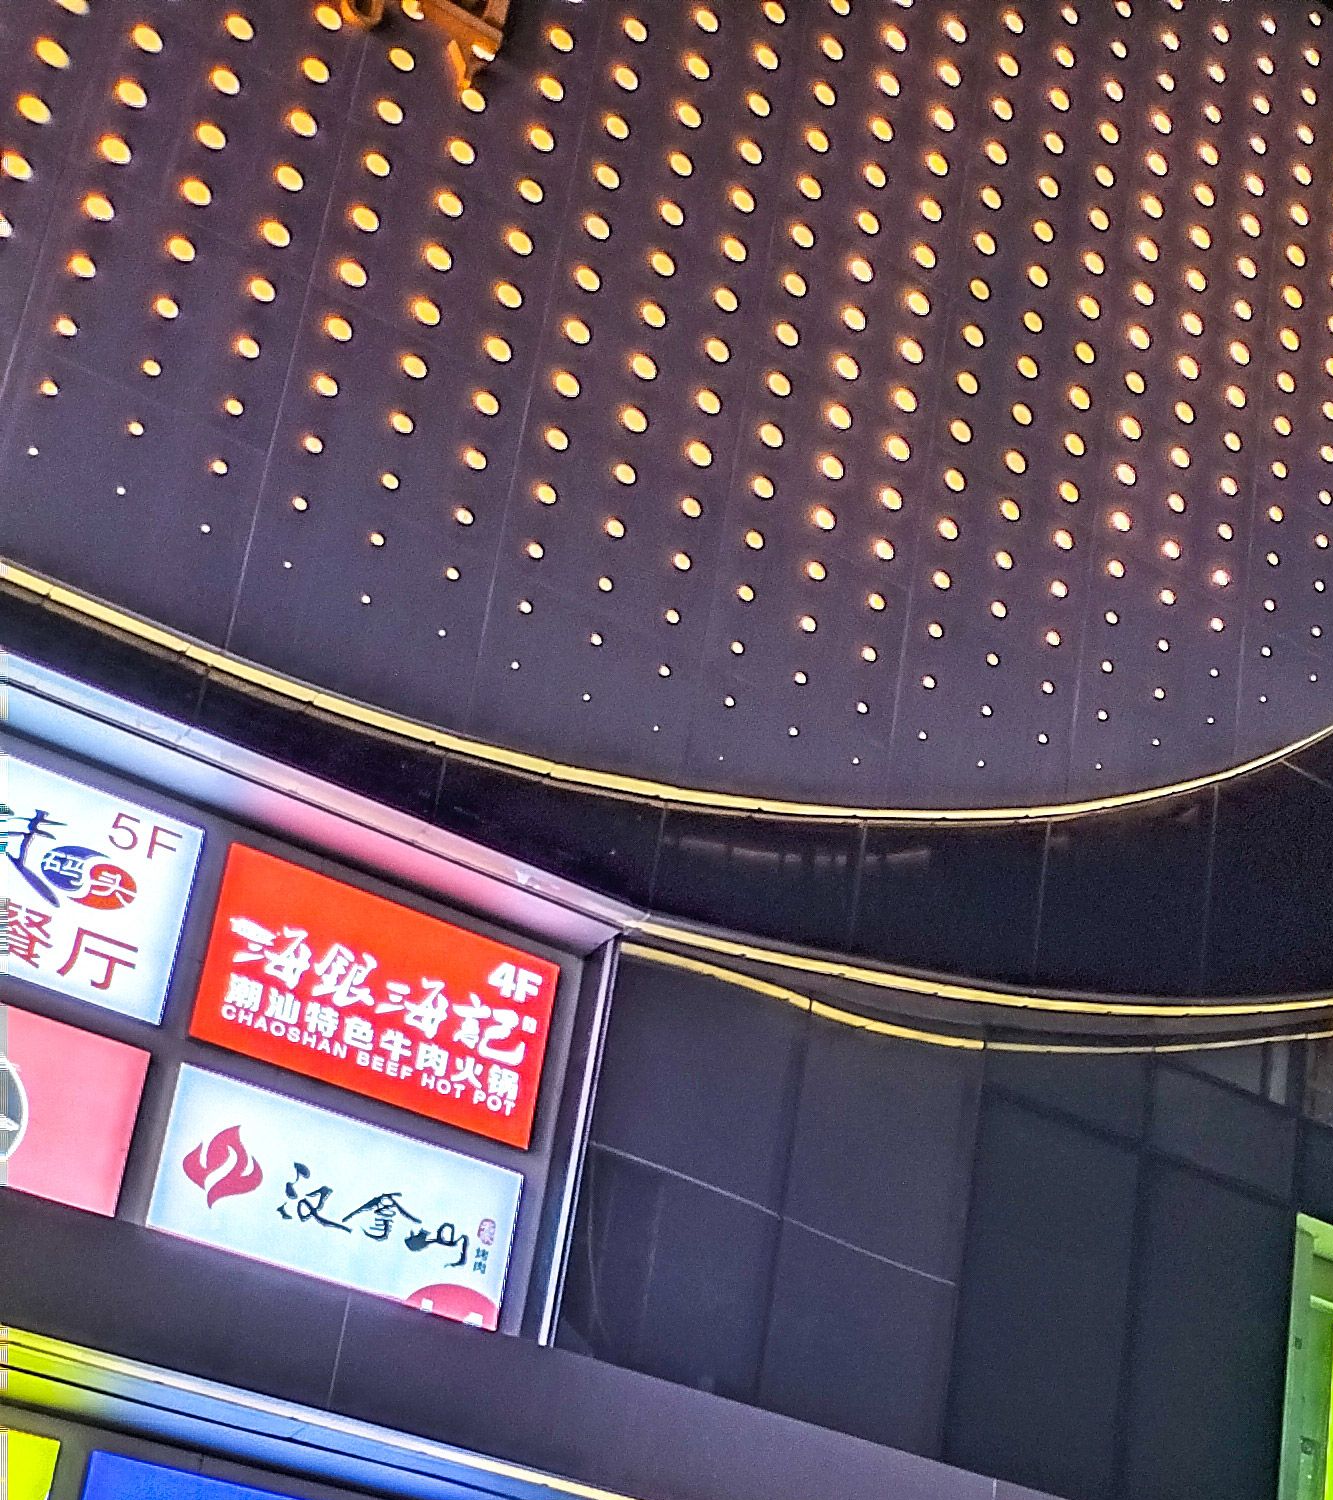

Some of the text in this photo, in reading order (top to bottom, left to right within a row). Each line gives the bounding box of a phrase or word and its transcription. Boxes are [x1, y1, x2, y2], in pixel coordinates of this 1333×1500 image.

[108, 812, 183, 860] 5F
[487, 961, 543, 1003] 4F
[221, 1003, 517, 1117] CHAOSHAN BEEF HOT POT
